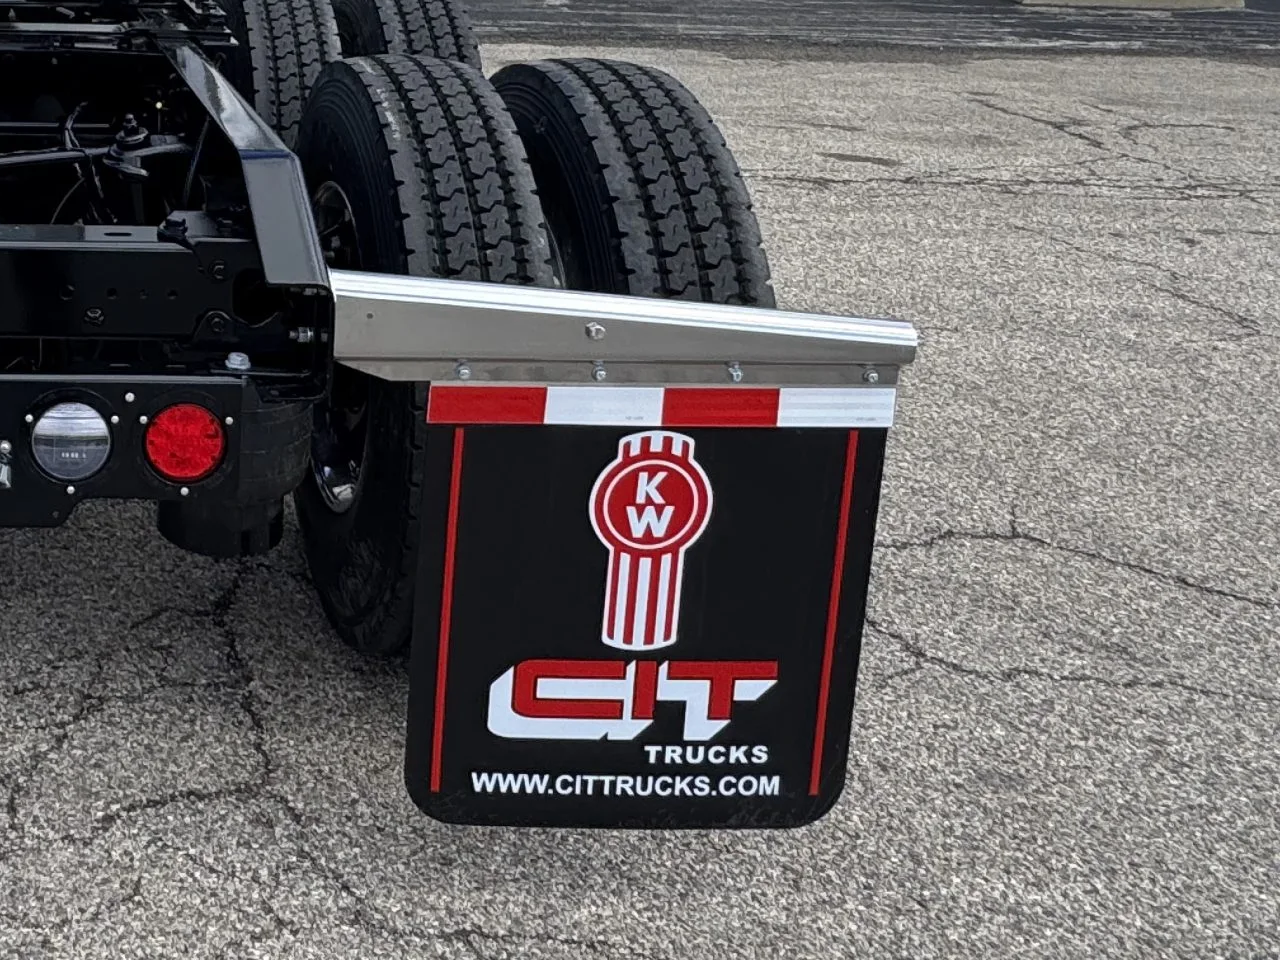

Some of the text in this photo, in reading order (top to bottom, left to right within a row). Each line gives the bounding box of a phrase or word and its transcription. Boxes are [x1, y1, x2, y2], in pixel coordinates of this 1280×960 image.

[487, 659, 778, 740] CIT
[644, 745, 769, 764] TRUCKS
[471, 772, 781, 797] WWW.CITTRUCKS.COM
